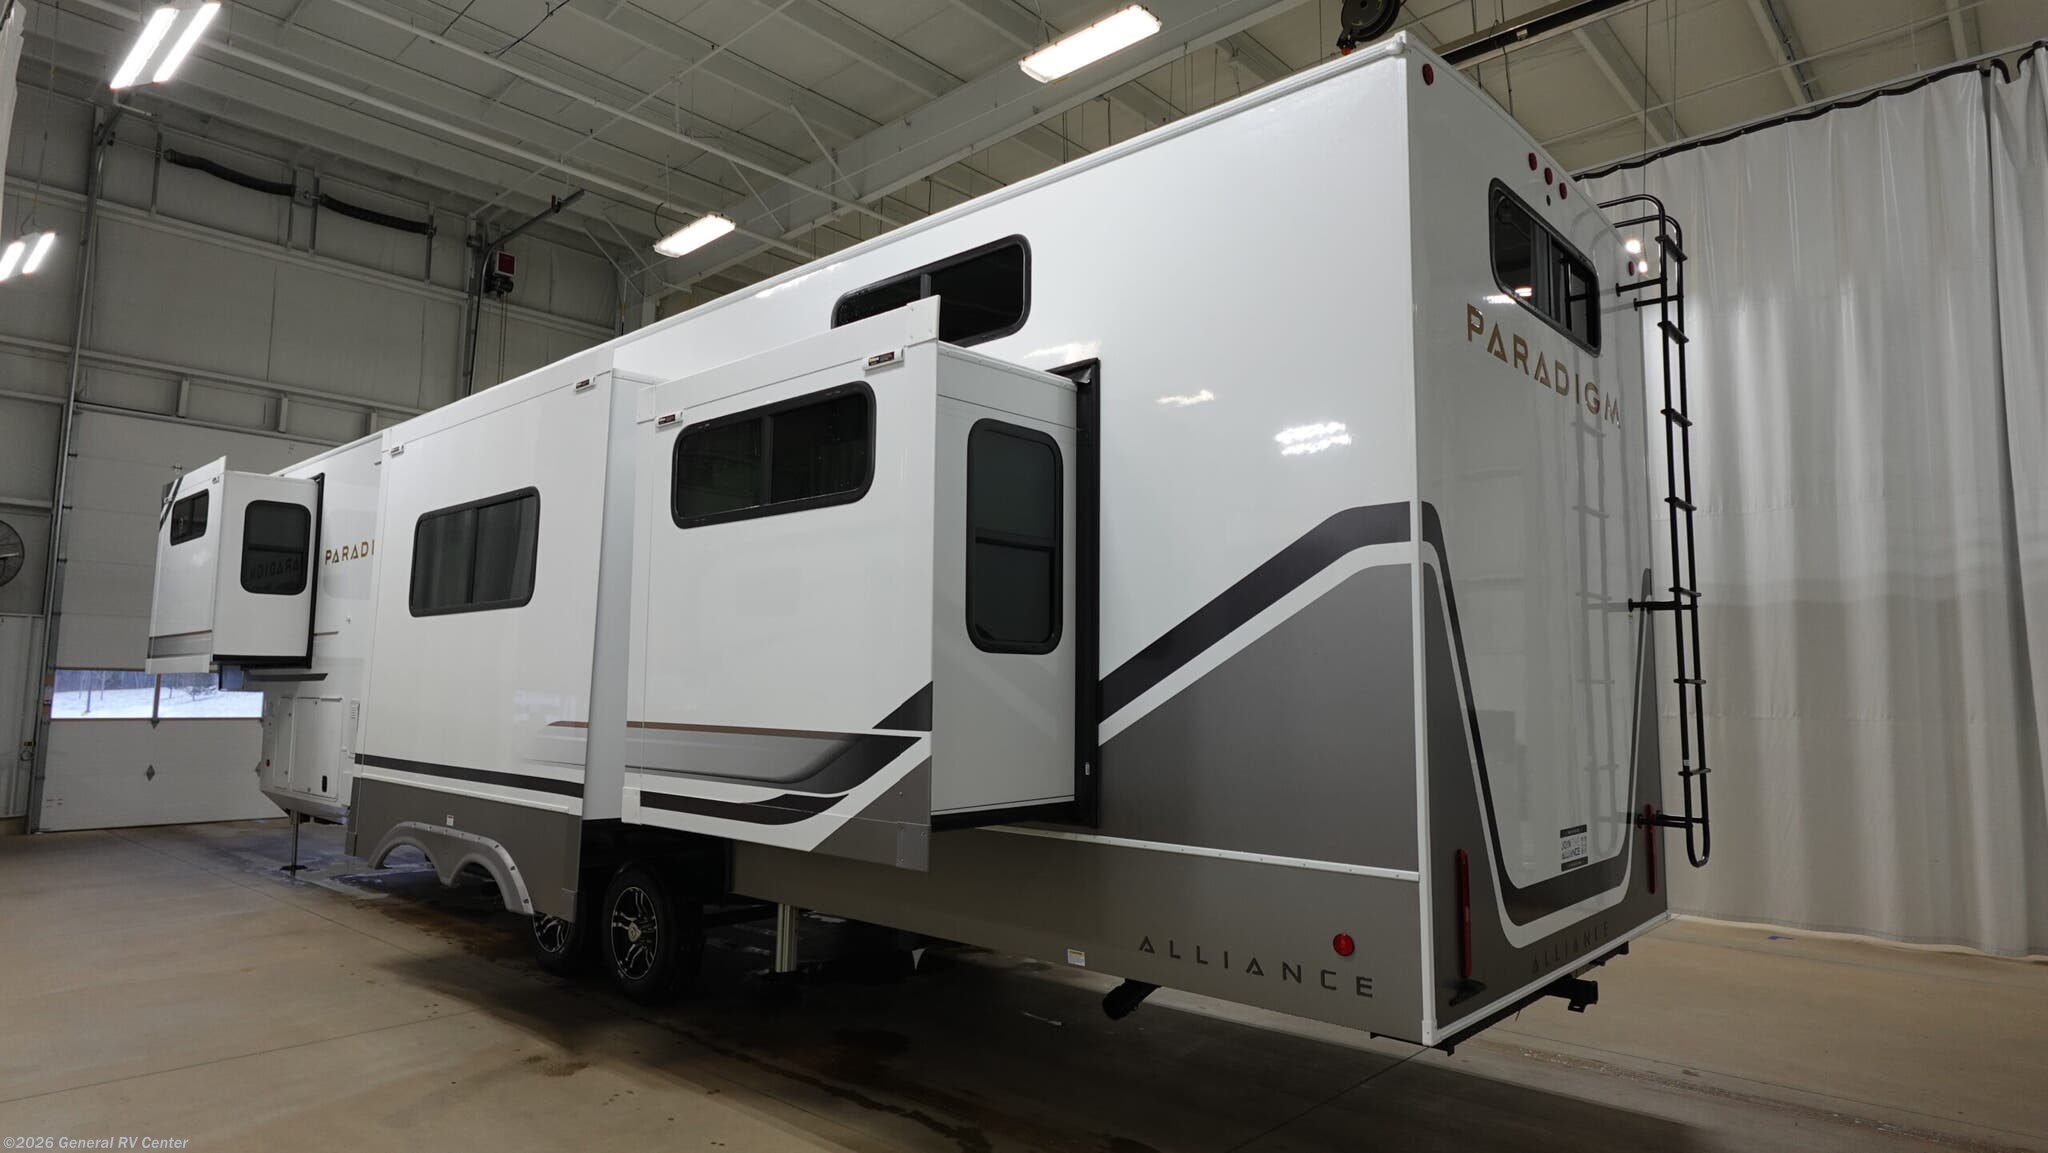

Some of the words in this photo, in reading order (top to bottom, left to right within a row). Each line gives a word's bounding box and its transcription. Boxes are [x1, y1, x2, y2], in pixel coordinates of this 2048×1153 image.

[1467, 303, 1621, 429] PARADIGM
[324, 539, 375, 565] PARADI
[1139, 935, 1373, 998] ALLIANCE
[1532, 921, 1609, 973] ALLIANCE
